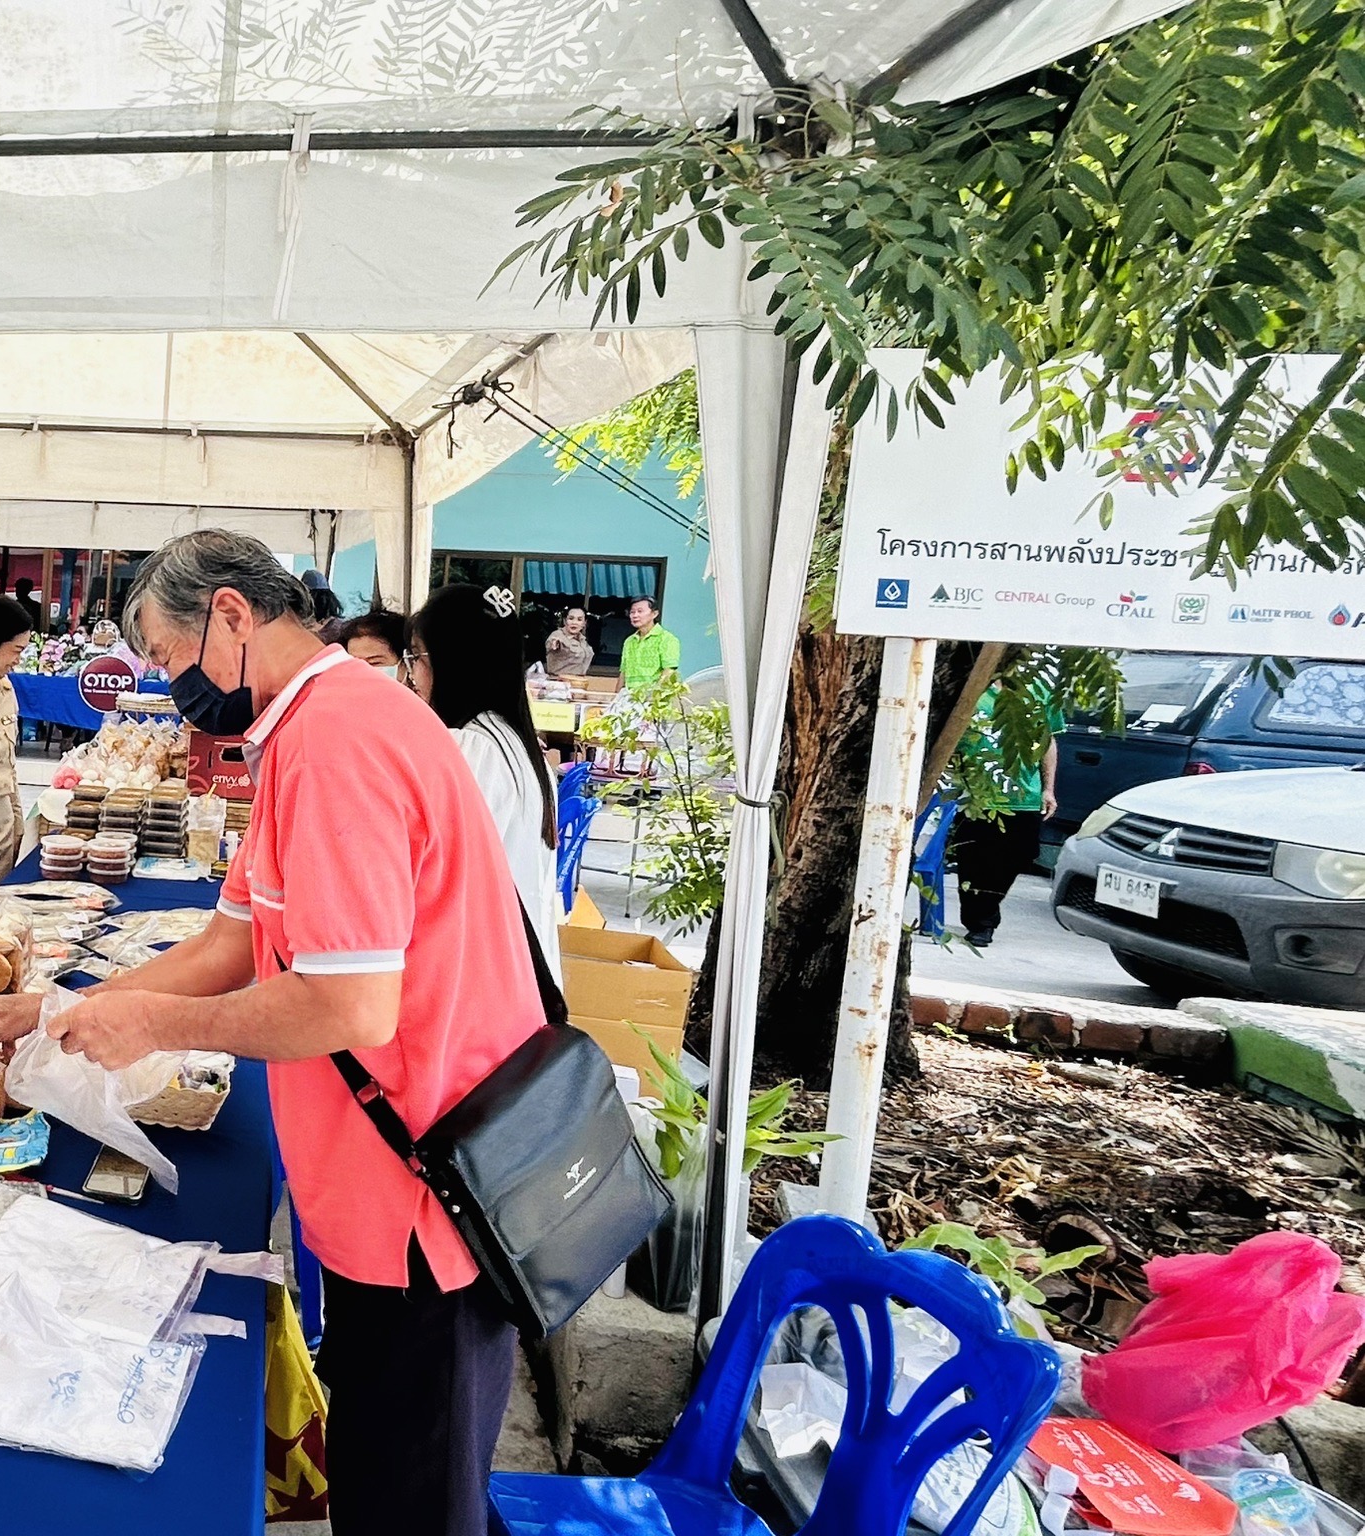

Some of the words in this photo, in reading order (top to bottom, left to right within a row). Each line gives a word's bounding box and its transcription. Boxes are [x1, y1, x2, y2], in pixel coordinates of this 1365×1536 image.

[954, 586, 984, 604] BJC
[994, 590, 1051, 604] CENTRAL
[1054, 592, 1096, 609] Group
[1251, 608, 1282, 618] MITR
[83, 672, 133, 689] OTOP
[212, 774, 239, 789] envy
